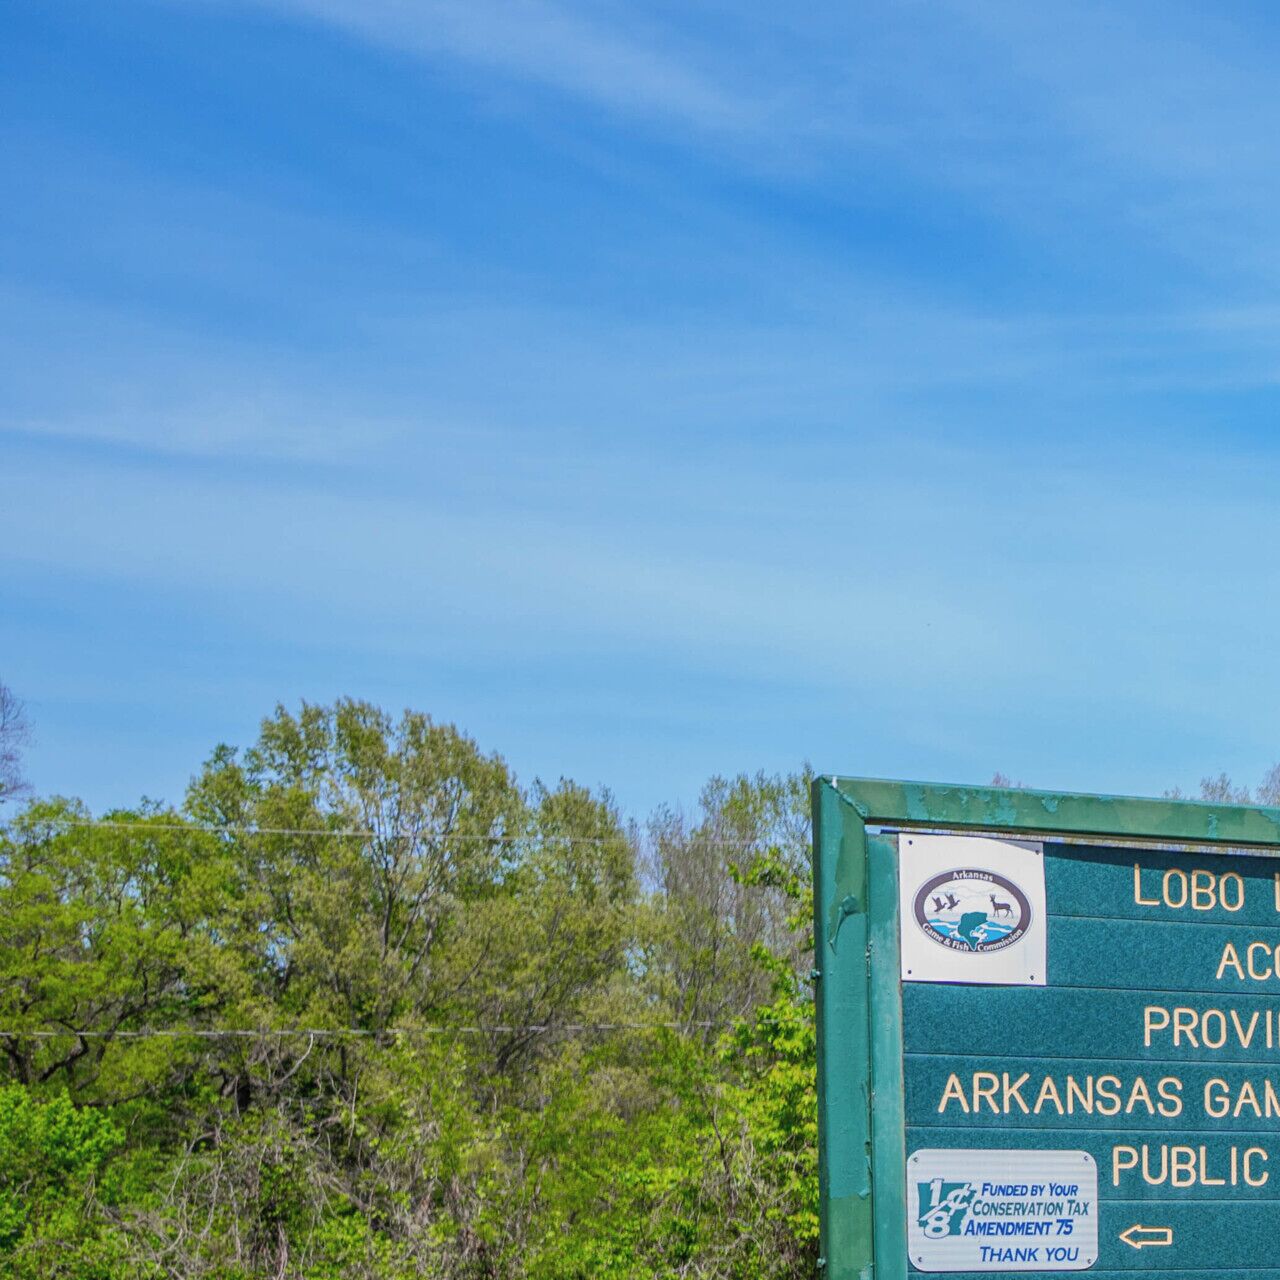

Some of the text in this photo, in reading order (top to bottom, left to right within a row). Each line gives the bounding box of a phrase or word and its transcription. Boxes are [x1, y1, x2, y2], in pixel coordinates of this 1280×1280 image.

[952, 870, 993, 881] Arkansas
[1134, 863, 1243, 913] LOBO
[922, 922, 1023, 952] Game & Fish Commission
[938, 1071, 1183, 1118] ARKANSAS
[1113, 1144, 1270, 1188] PUBLIC
[1056, 1218, 1074, 1236] 75
[1045, 1247, 1080, 1262] YOU
